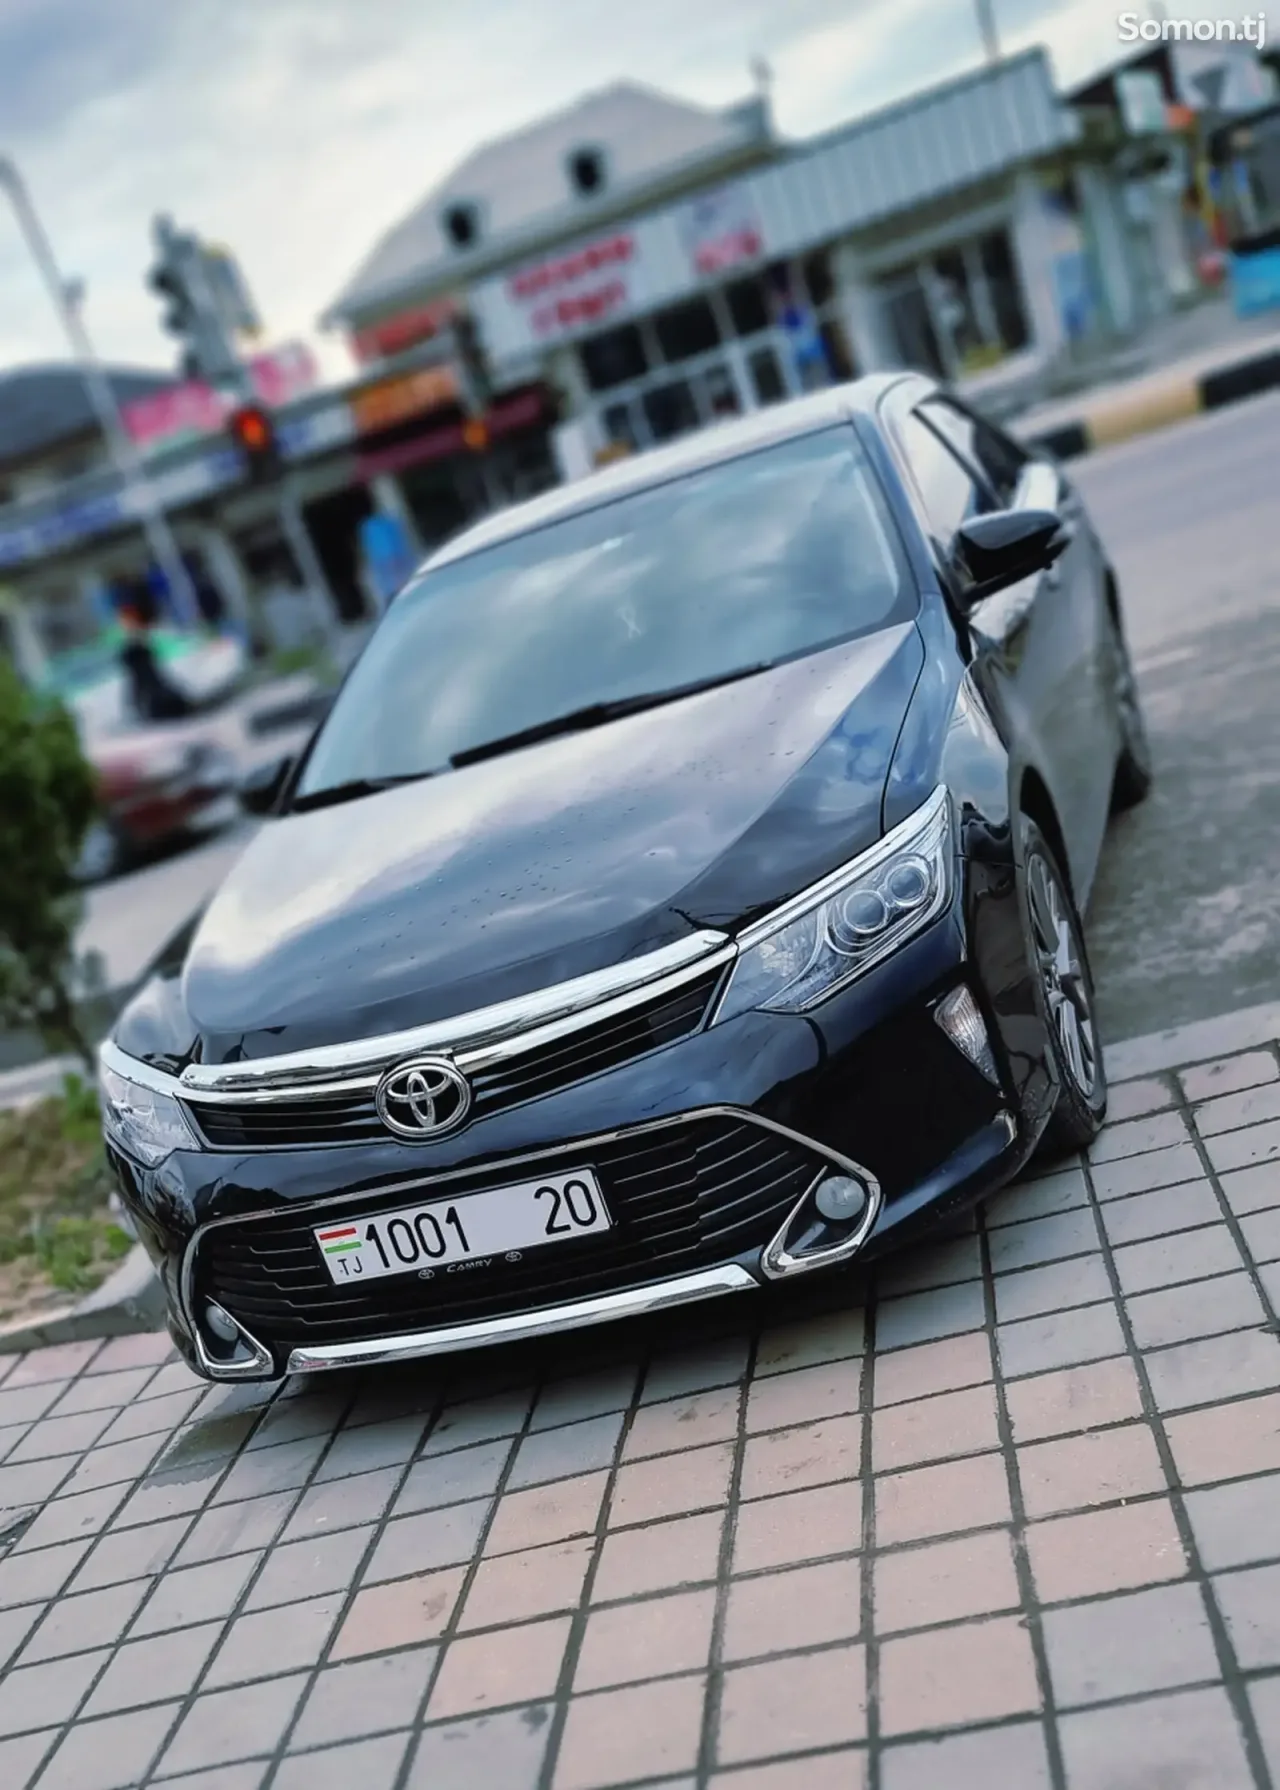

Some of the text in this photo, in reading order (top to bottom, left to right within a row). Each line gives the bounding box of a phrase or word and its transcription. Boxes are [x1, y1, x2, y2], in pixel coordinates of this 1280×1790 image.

[365, 1179, 598, 1268] 1001 20
[339, 1256, 363, 1276] TJ
[446, 1258, 492, 1273] CAMRY
